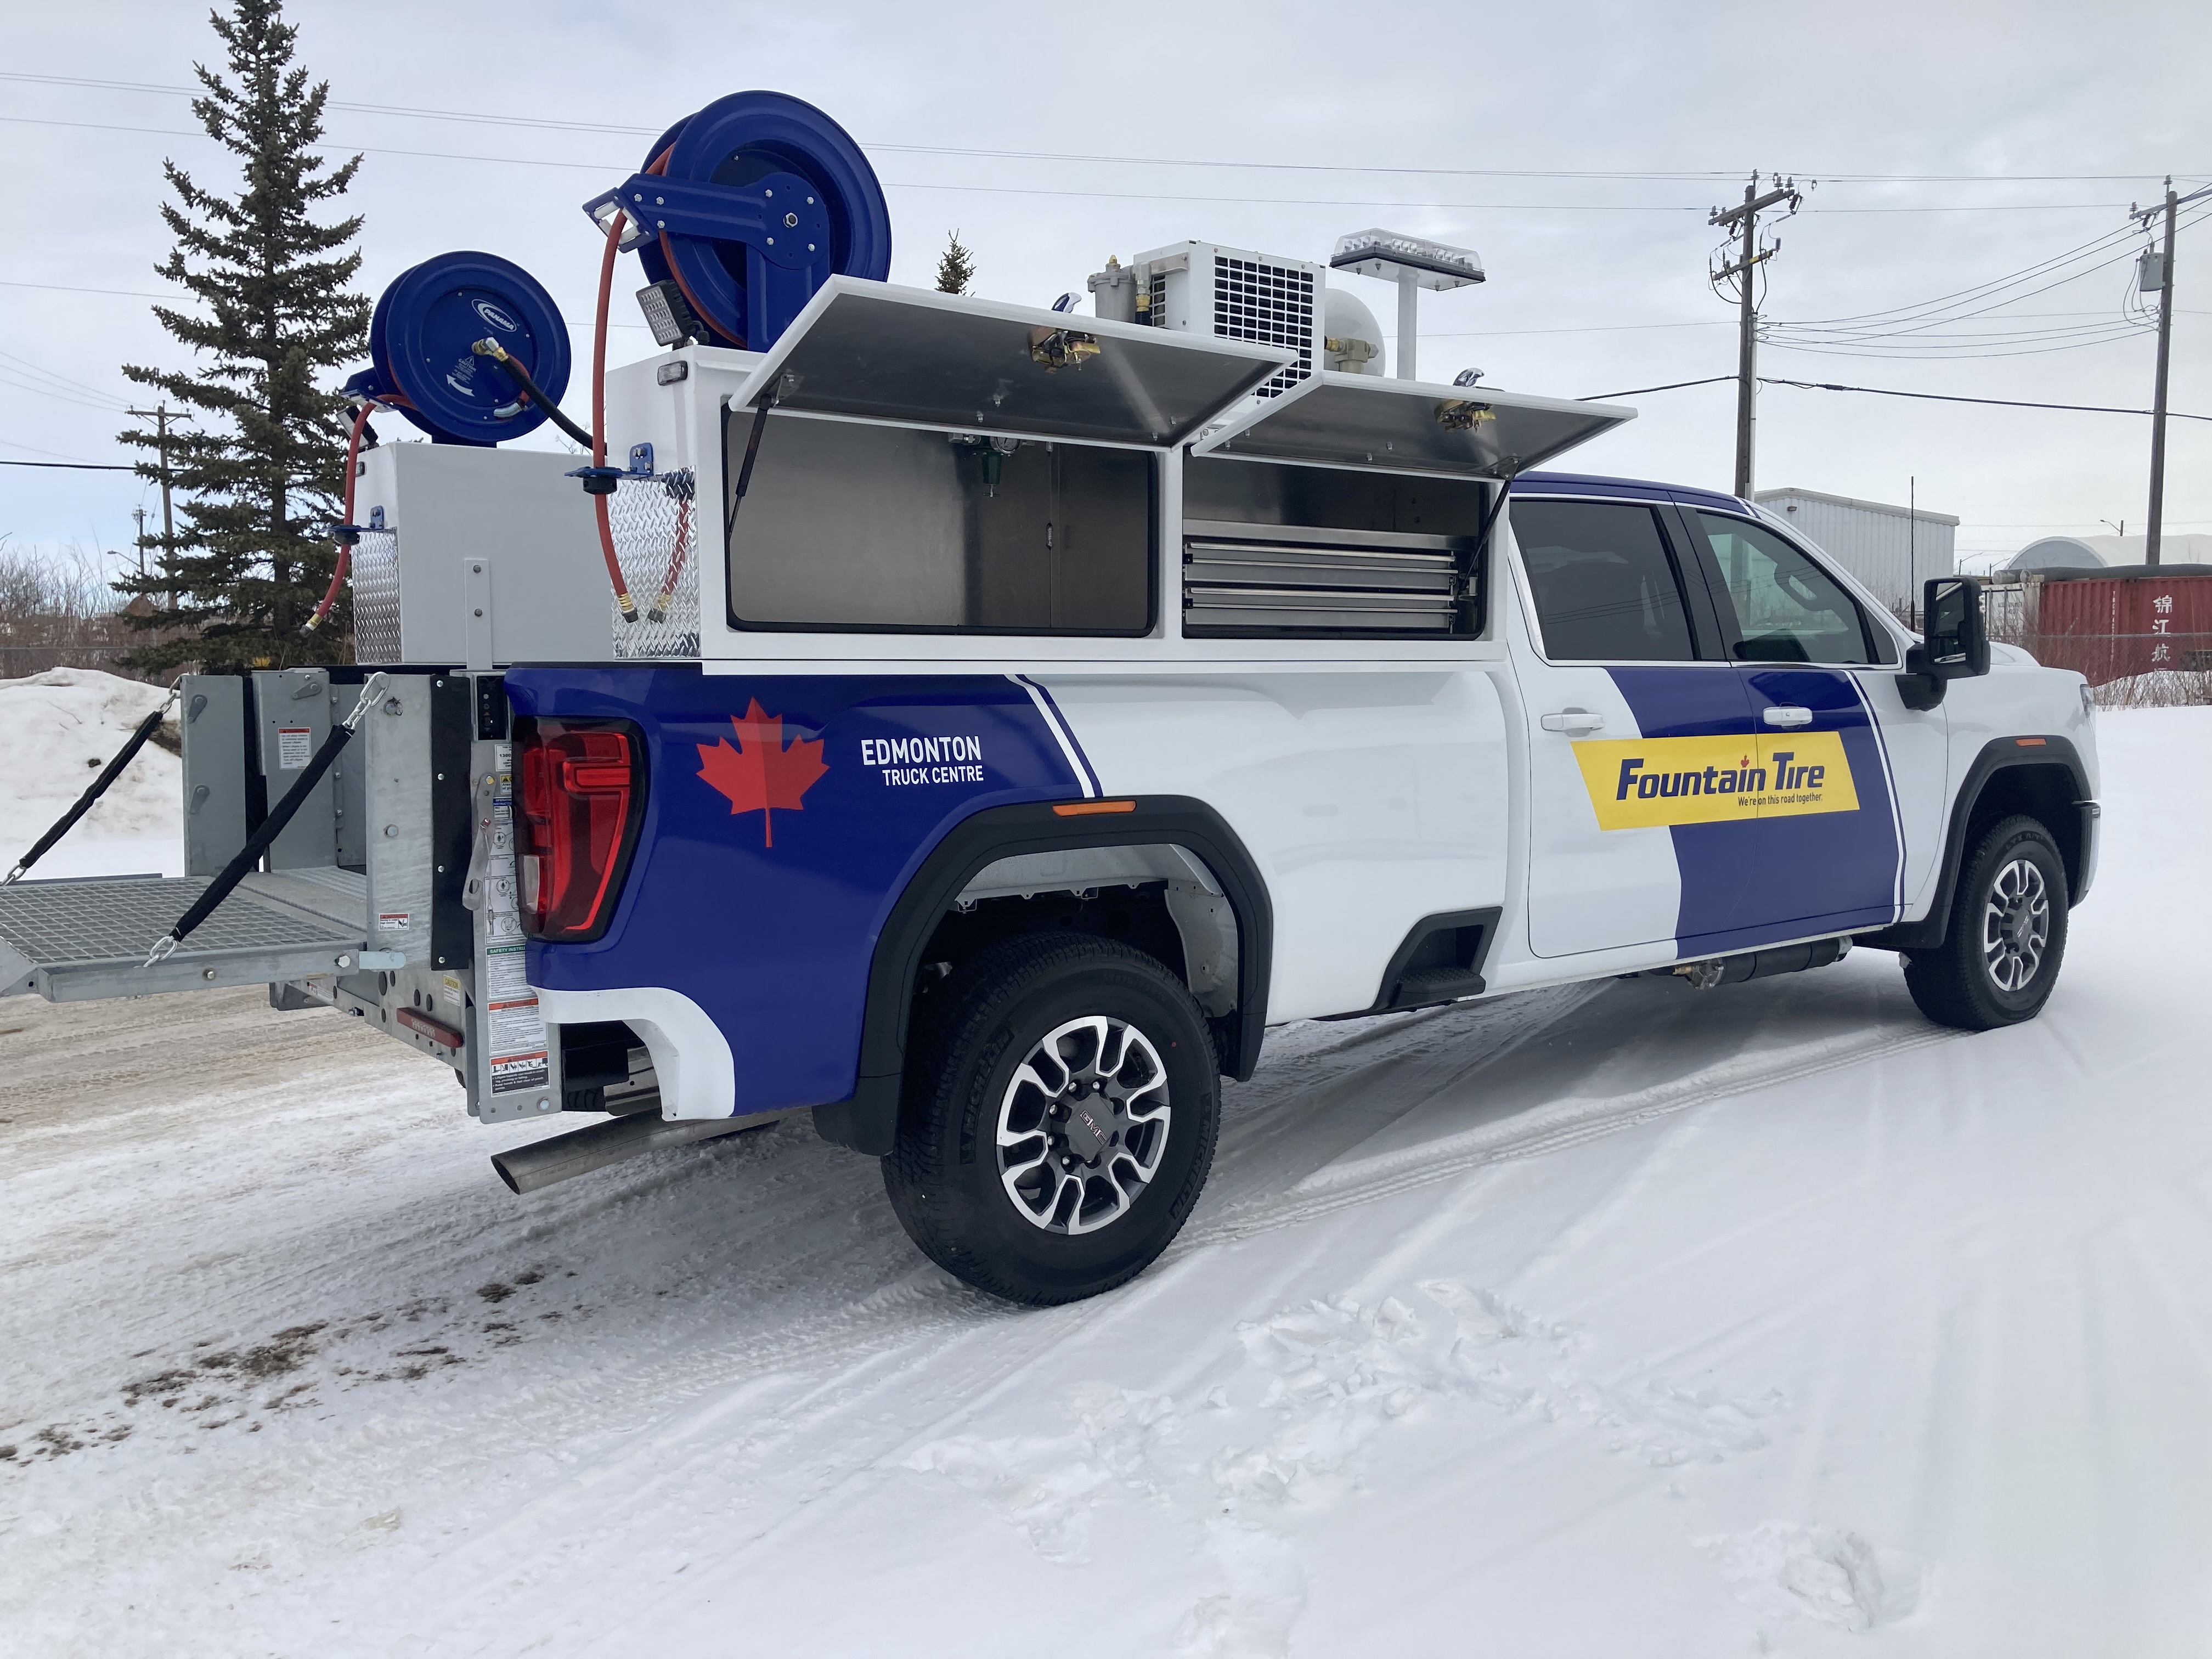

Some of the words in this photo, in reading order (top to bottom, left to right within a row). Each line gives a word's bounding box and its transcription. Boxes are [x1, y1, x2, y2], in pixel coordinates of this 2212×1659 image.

[484, 308, 514, 330] PANAMA
[2152, 595, 2172, 670] 锦江航
[861, 736, 981, 765] EDMONTON
[882, 768, 930, 786] TRUCK
[932, 765, 984, 783] CENTRE
[1616, 757, 1767, 801] Fountain
[1772, 752, 1825, 790] Tire
[1738, 796, 1756, 806] We're
[1768, 794, 1779, 804] this
[1781, 793, 1795, 804] road
[1797, 792, 1822, 804] together.
[1080, 1110, 1107, 1145] GMC
